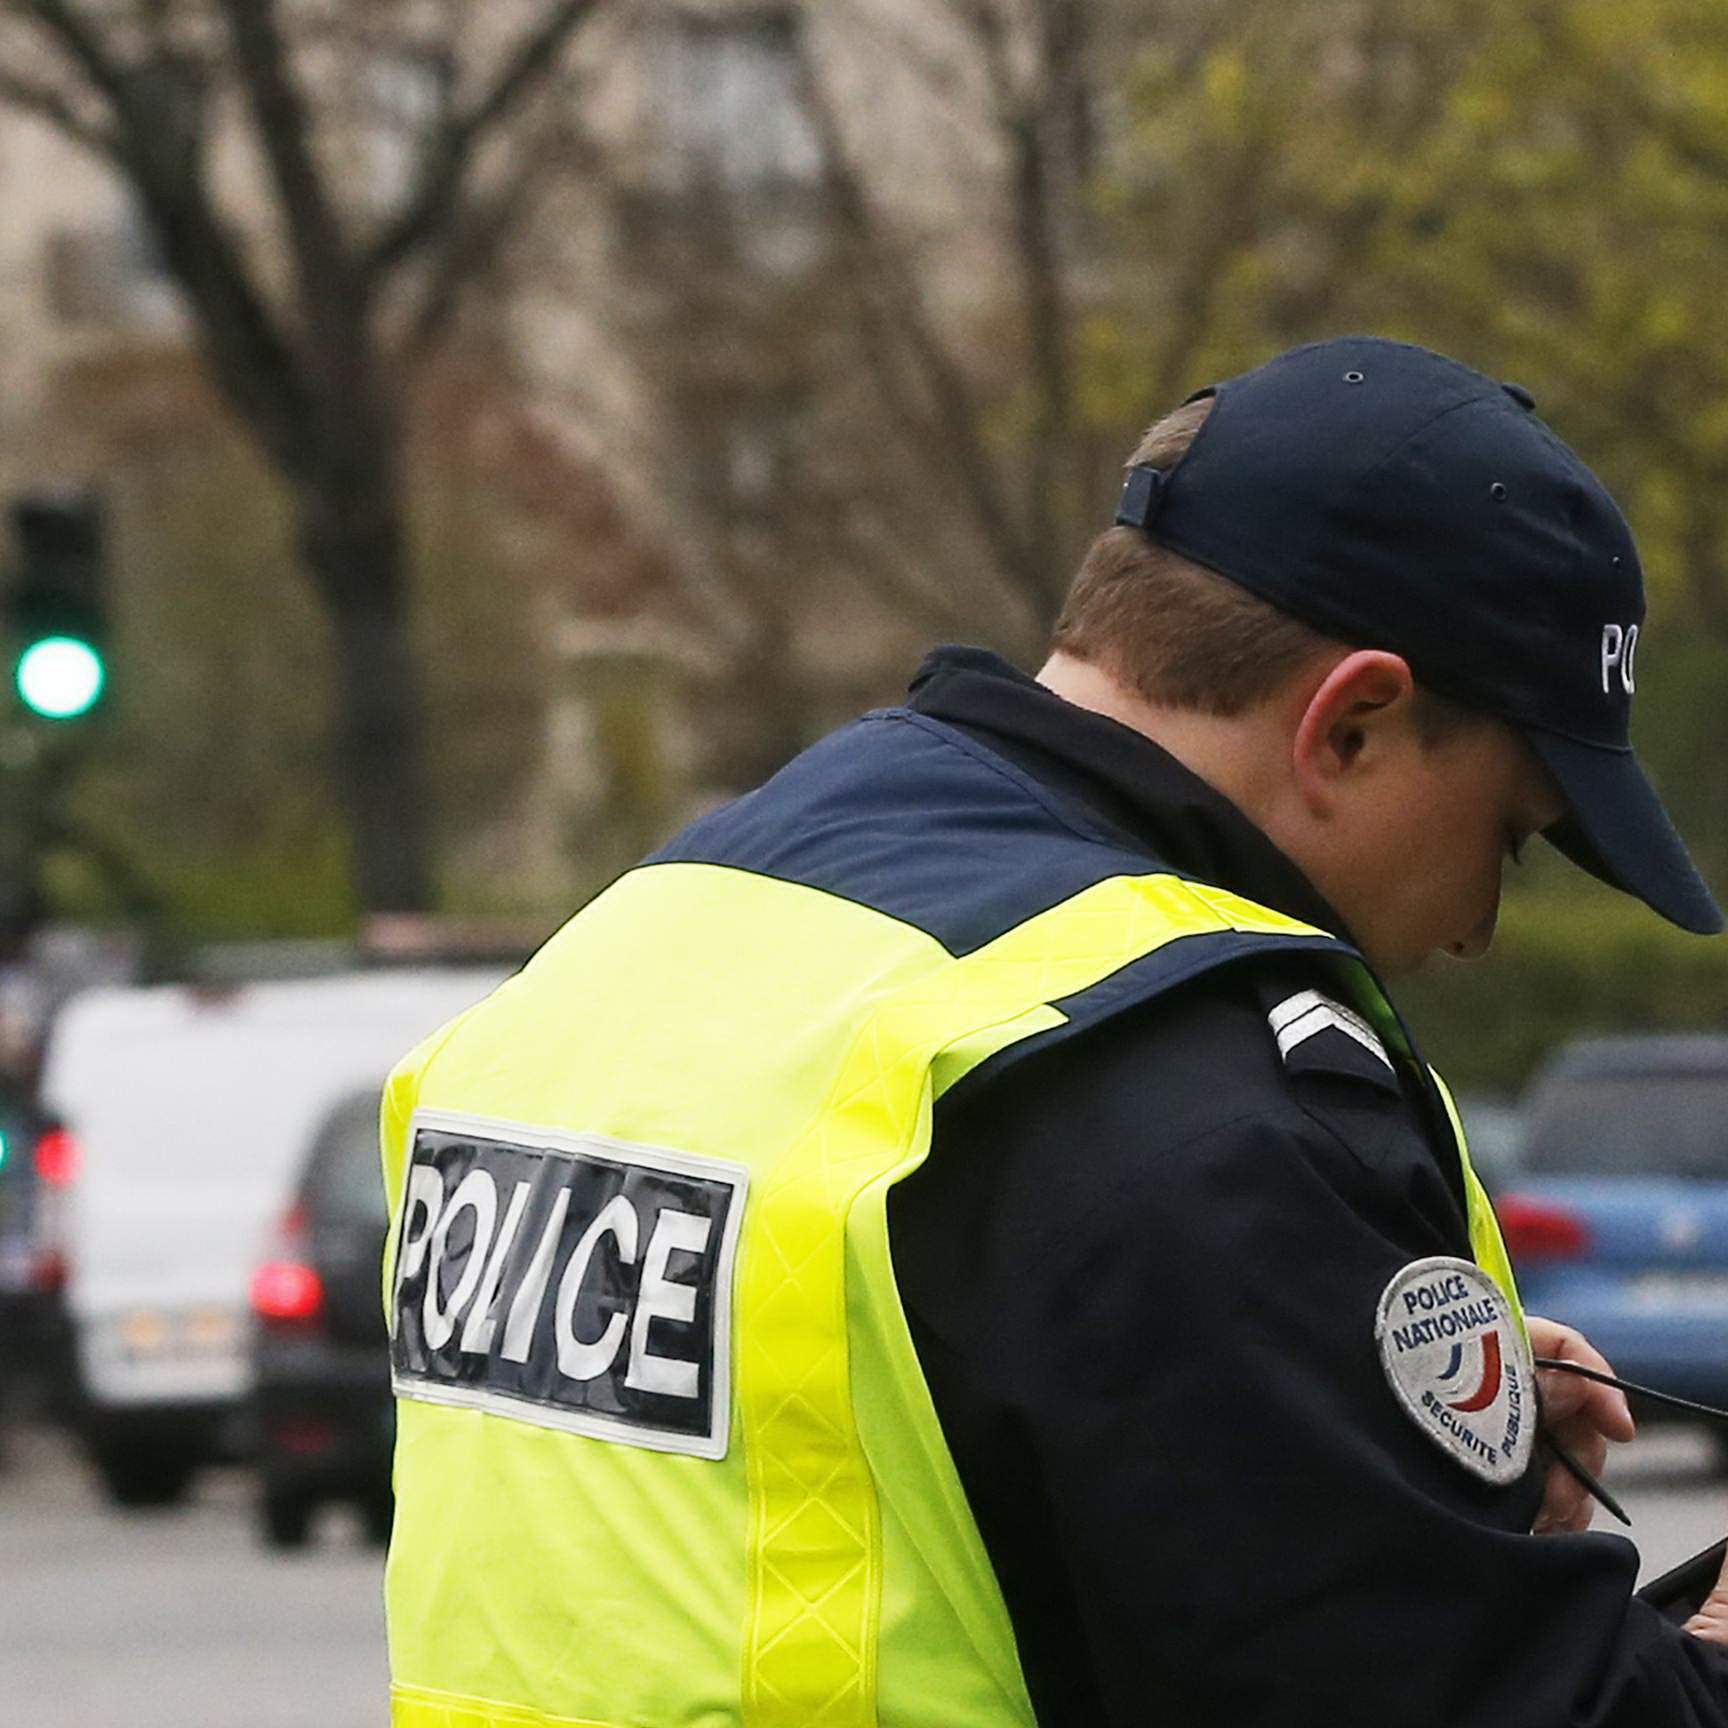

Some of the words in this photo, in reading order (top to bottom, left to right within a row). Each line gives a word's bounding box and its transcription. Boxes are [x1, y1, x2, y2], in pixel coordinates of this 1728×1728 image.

[392, 1163, 712, 1399] POLICE
[1403, 1274, 1470, 1315] POLICE
[1391, 1299, 1498, 1353] NATIONALE
[1421, 1389, 1497, 1466] SECURITE
